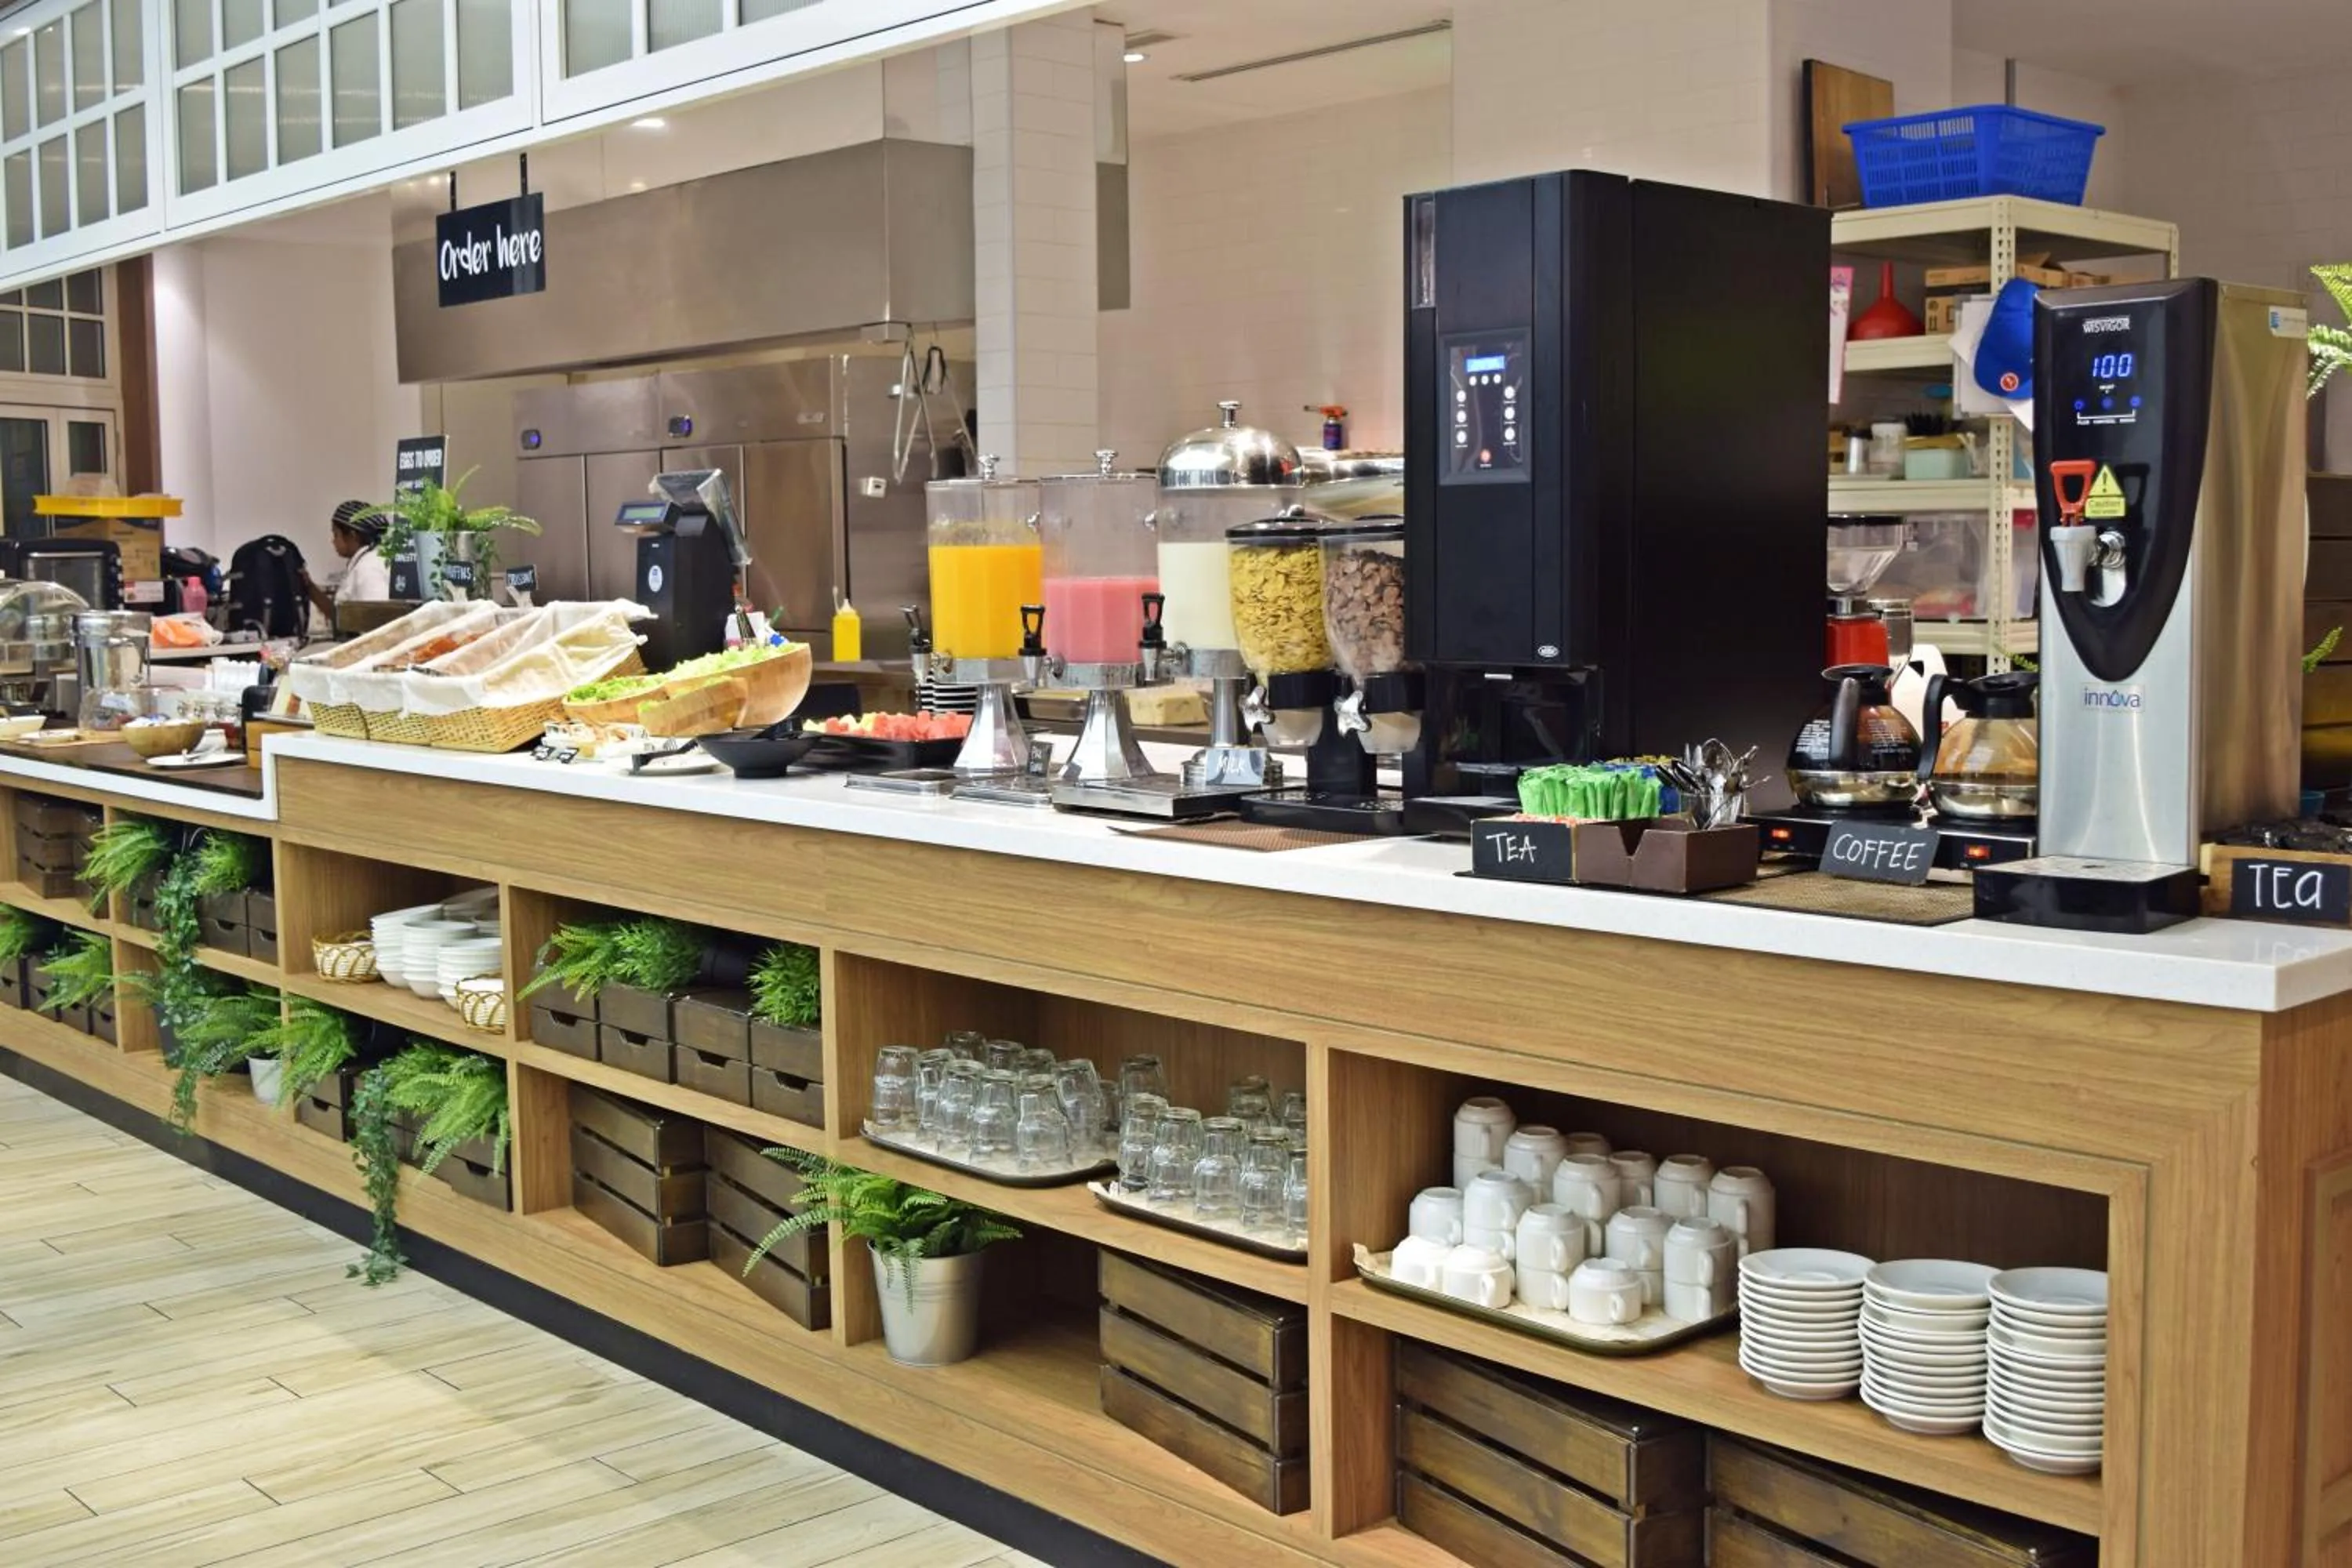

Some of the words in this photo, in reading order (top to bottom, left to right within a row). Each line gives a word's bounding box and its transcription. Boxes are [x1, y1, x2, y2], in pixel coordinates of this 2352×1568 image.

[440, 231, 492, 281] Order
[496, 224, 542, 270] here
[2092, 354, 2132, 378] 100
[1486, 832, 1537, 863] TEA
[1832, 833, 1926, 871] COFFEE
